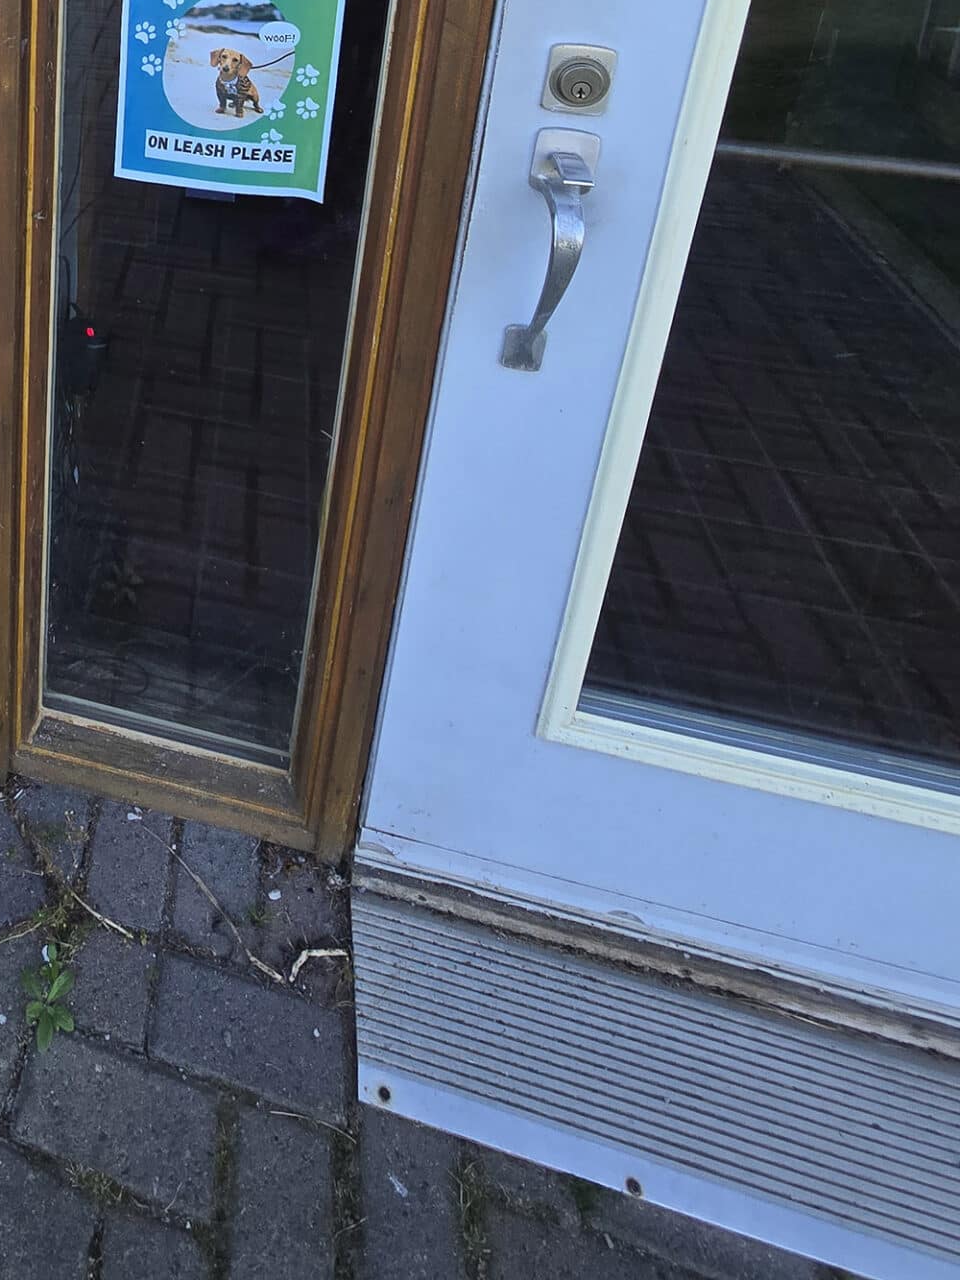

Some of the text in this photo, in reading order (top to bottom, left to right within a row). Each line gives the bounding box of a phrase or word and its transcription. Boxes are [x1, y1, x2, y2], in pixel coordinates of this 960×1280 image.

[148, 135, 294, 163] ON LEASH PLEASE
